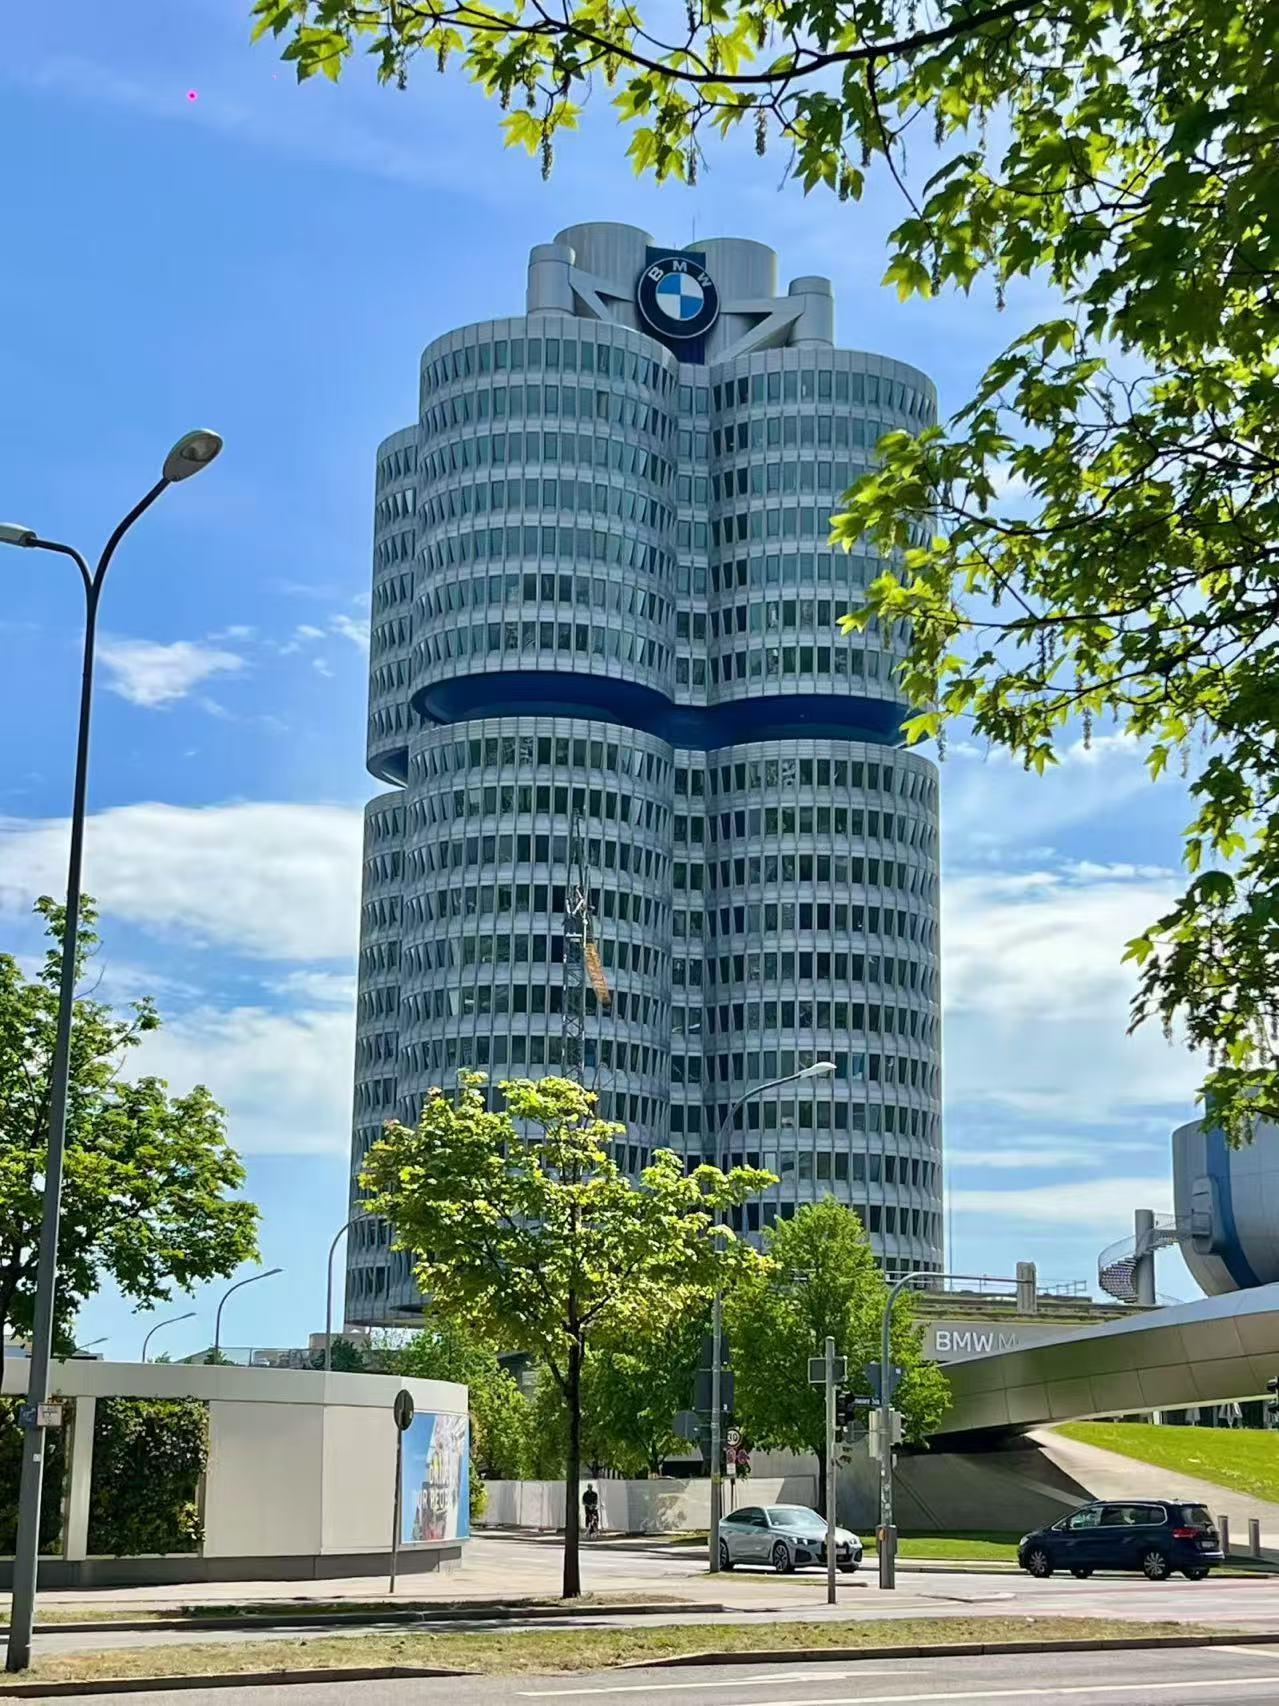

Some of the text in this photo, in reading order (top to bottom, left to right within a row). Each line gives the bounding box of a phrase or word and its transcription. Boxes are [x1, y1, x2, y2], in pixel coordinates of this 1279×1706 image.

[647, 260, 712, 288] BMW
[935, 1330, 1020, 1352] BMW M
